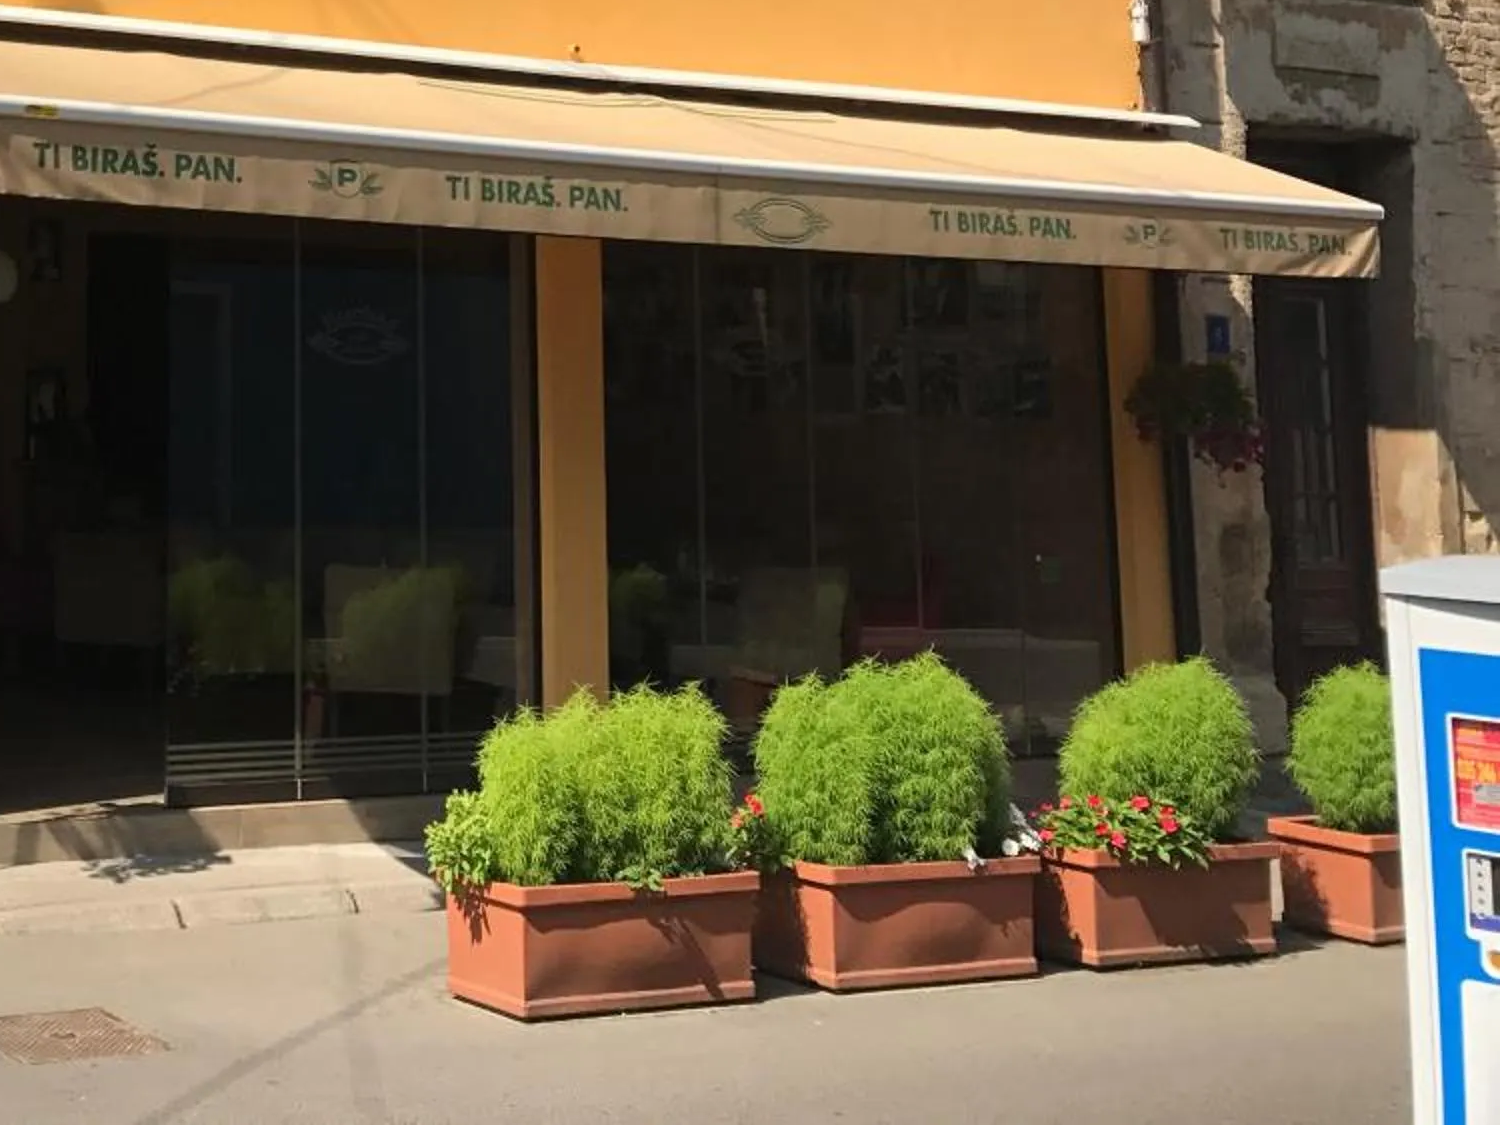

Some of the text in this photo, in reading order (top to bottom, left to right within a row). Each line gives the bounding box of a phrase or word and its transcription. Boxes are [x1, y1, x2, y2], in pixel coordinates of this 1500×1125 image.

[33, 142, 243, 183] TI BIRAŠ. PAN.
[338, 168, 357, 187] P
[445, 175, 629, 212] TI BIRAŠ. PAN.
[929, 207, 1077, 240] TI BIRAŠ. PAN.
[1142, 224, 1157, 241] P
[1219, 228, 1238, 251] TI
